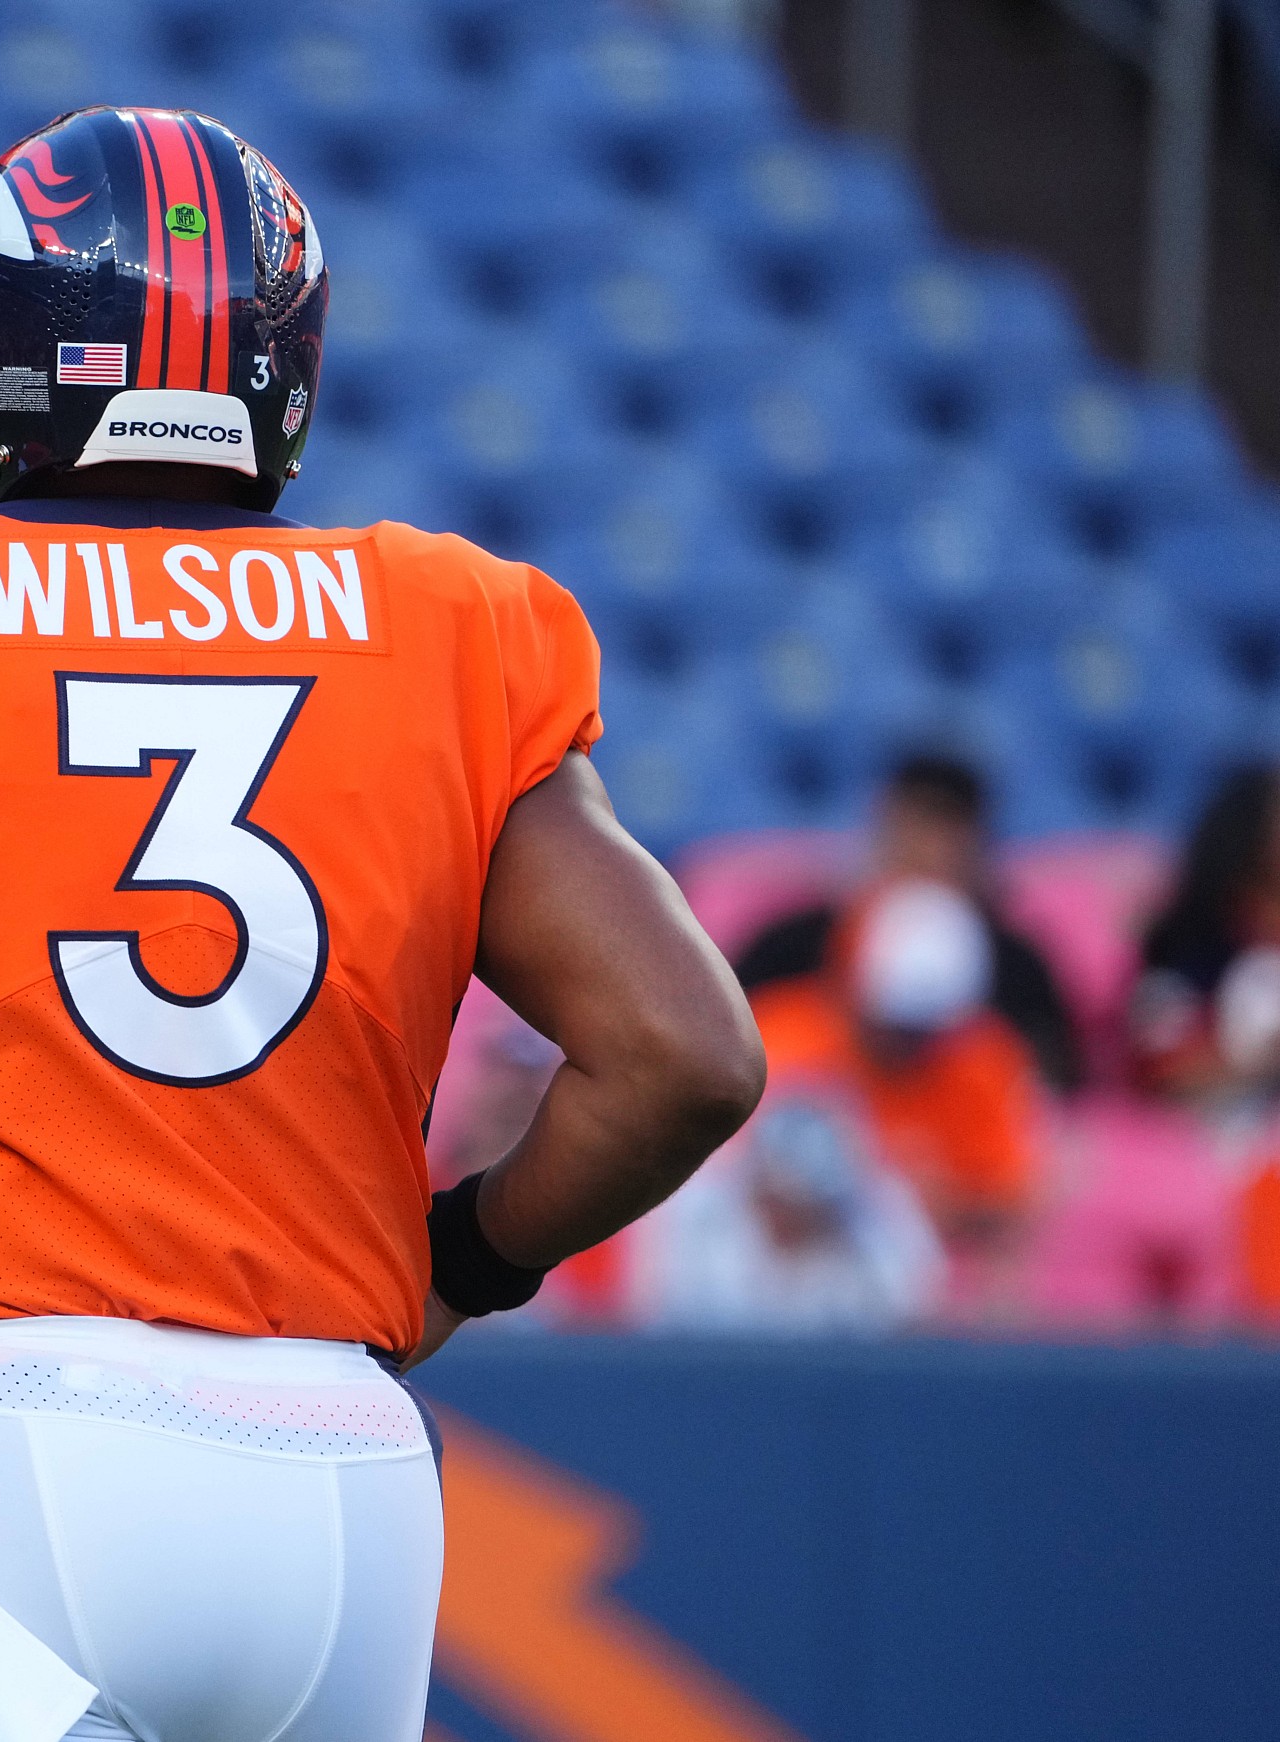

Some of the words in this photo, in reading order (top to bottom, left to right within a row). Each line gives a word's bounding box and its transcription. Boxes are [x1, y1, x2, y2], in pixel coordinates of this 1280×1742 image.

[178, 214, 194, 225] NFL
[251, 355, 270, 390] 3
[109, 421, 242, 444] BRONCOS
[47, 671, 329, 1088] 3
